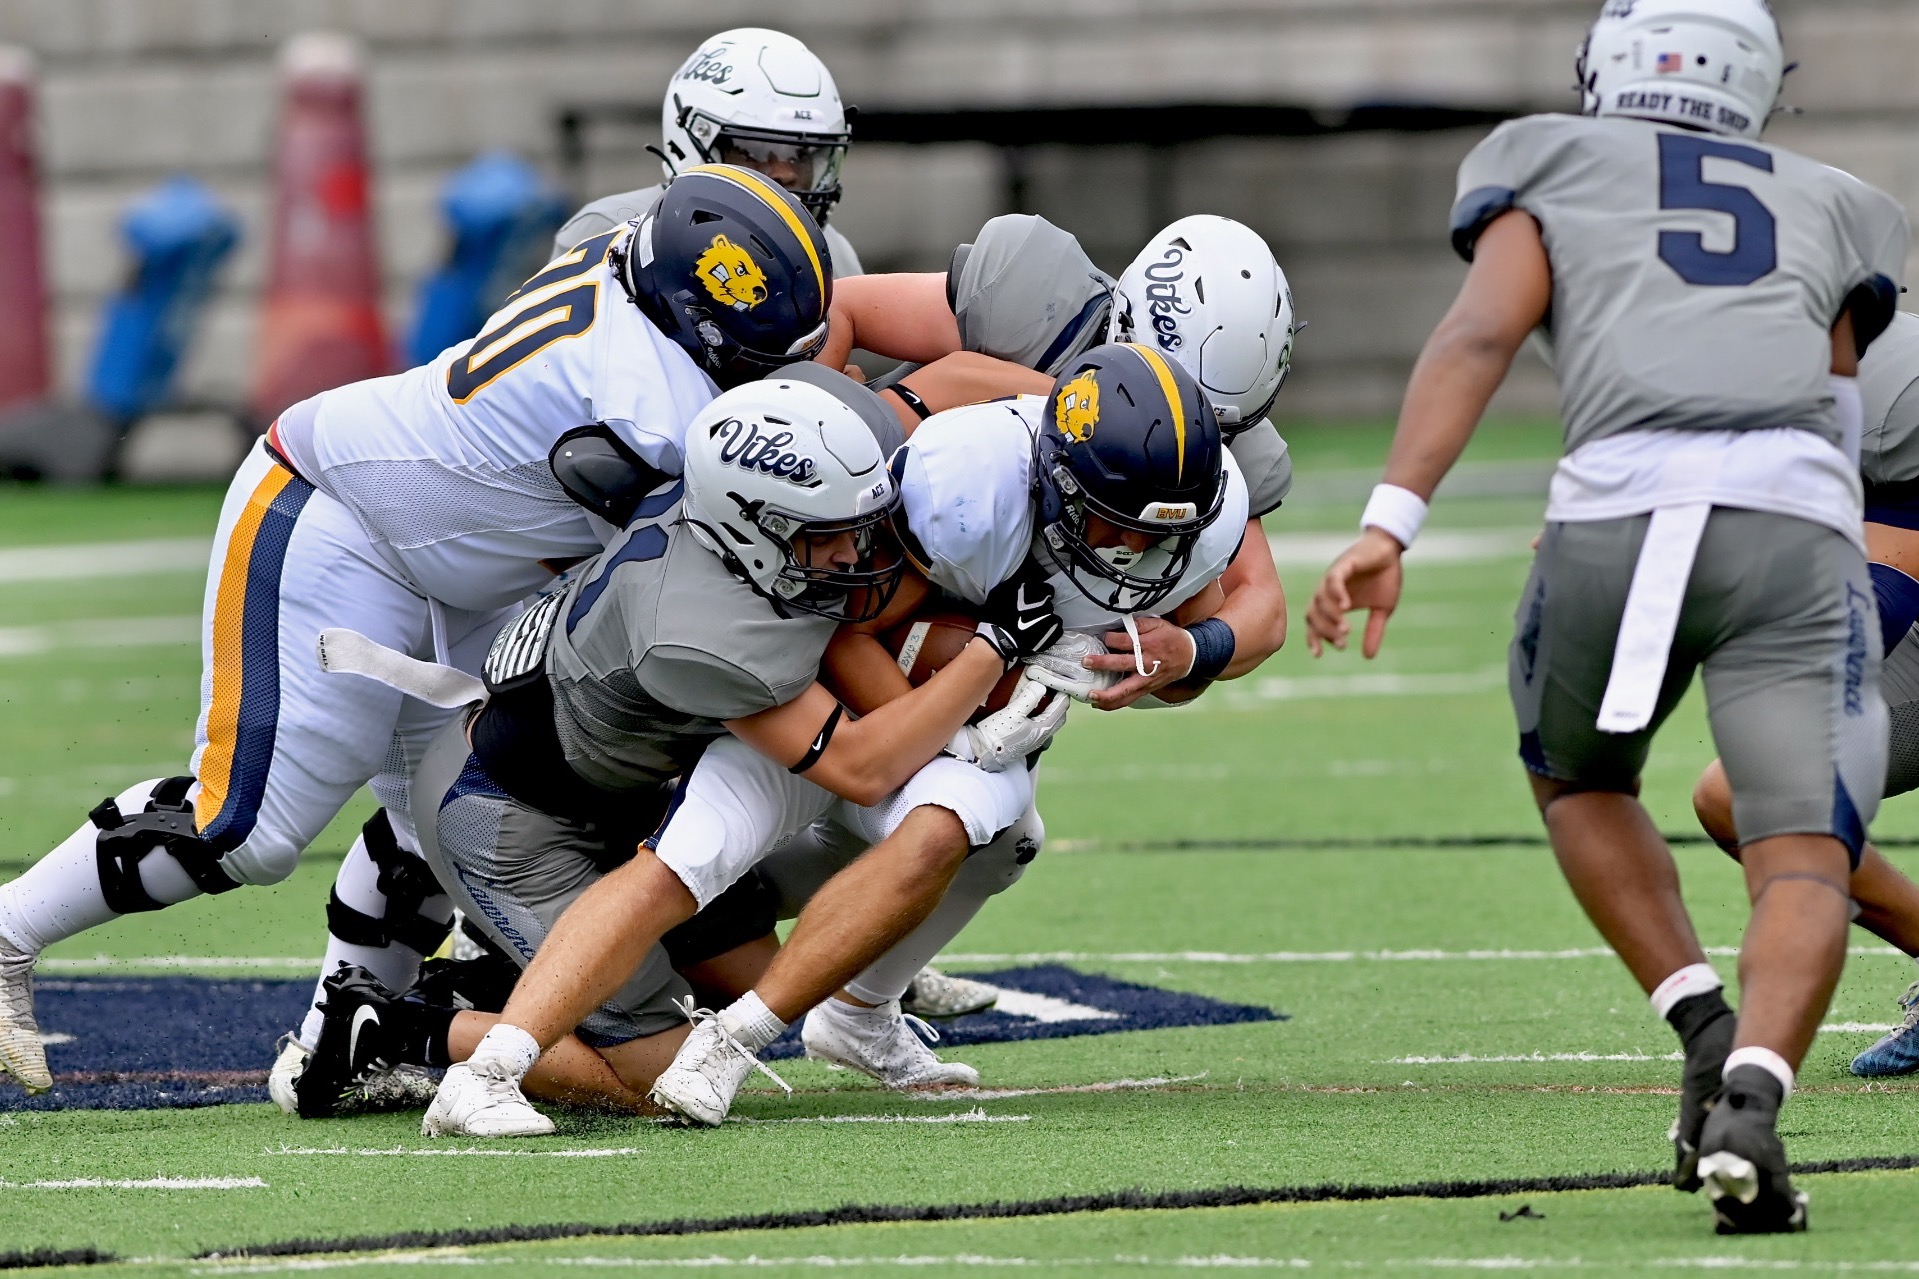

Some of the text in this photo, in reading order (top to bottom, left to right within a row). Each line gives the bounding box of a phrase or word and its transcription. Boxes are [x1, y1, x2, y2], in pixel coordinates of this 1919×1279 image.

[794, 110, 812, 120] ACE
[1616, 91, 1750, 132] READY THE SHIP
[1657, 132, 1776, 286] 5
[1145, 249, 1191, 352] Vikes
[1214, 407, 1226, 416] CE
[720, 420, 814, 482] Vikes
[872, 483, 884, 499] ACE
[1156, 508, 1187, 519] BVU
